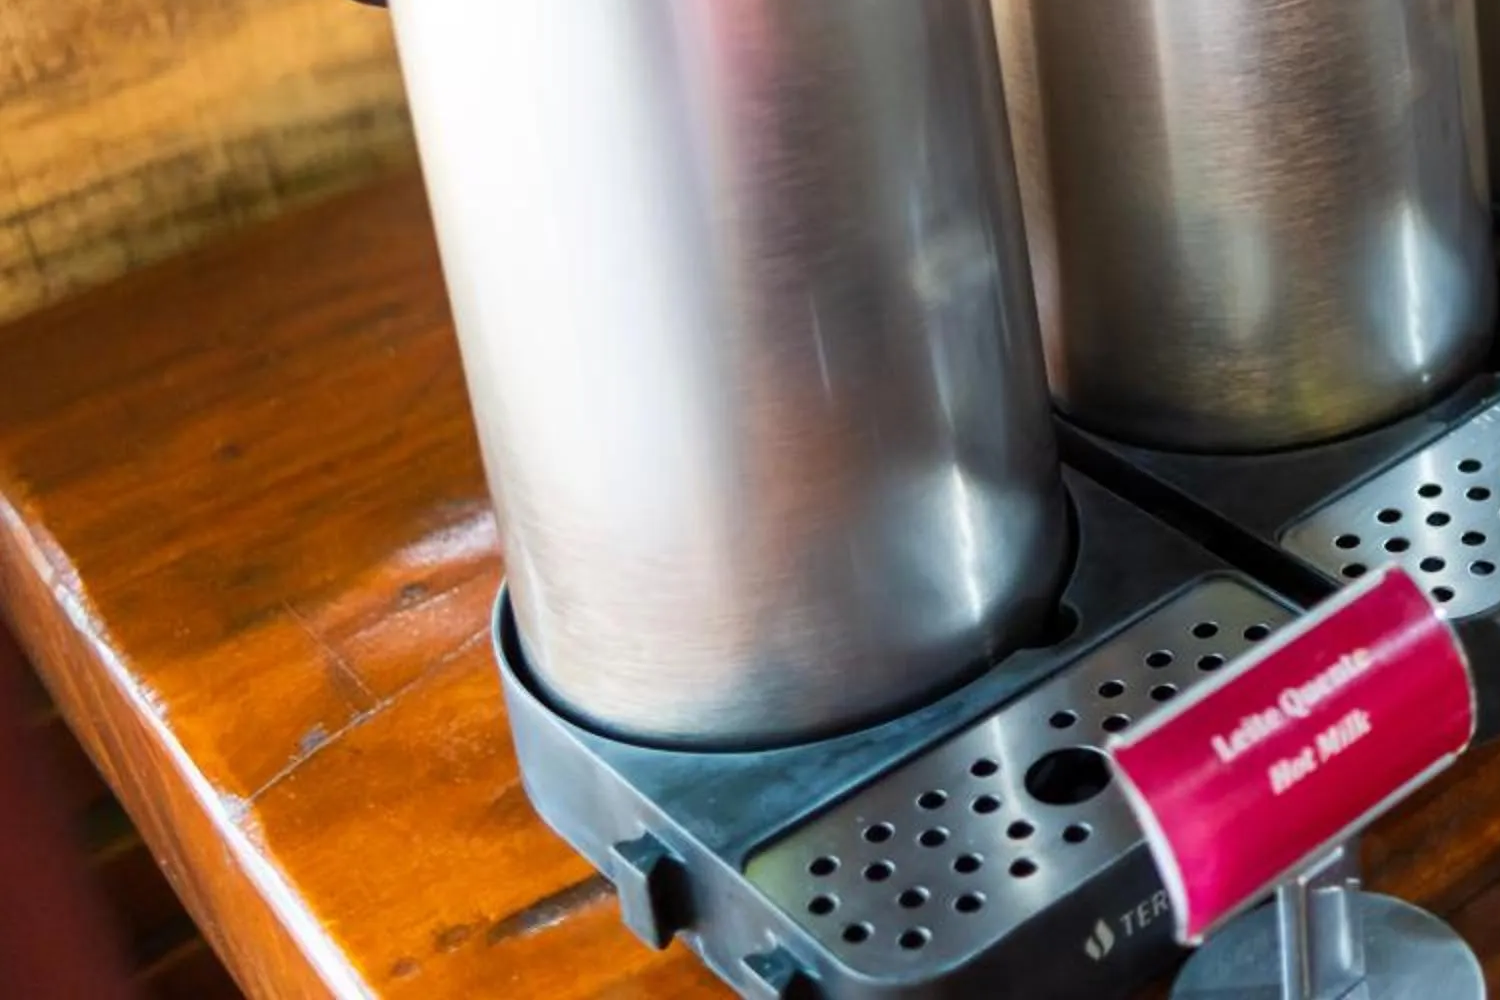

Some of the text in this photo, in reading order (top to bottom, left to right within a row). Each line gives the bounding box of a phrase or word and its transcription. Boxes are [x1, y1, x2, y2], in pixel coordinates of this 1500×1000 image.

[1211, 648, 1373, 763] Leite Quente
[1268, 708, 1372, 796] Hot Milk
